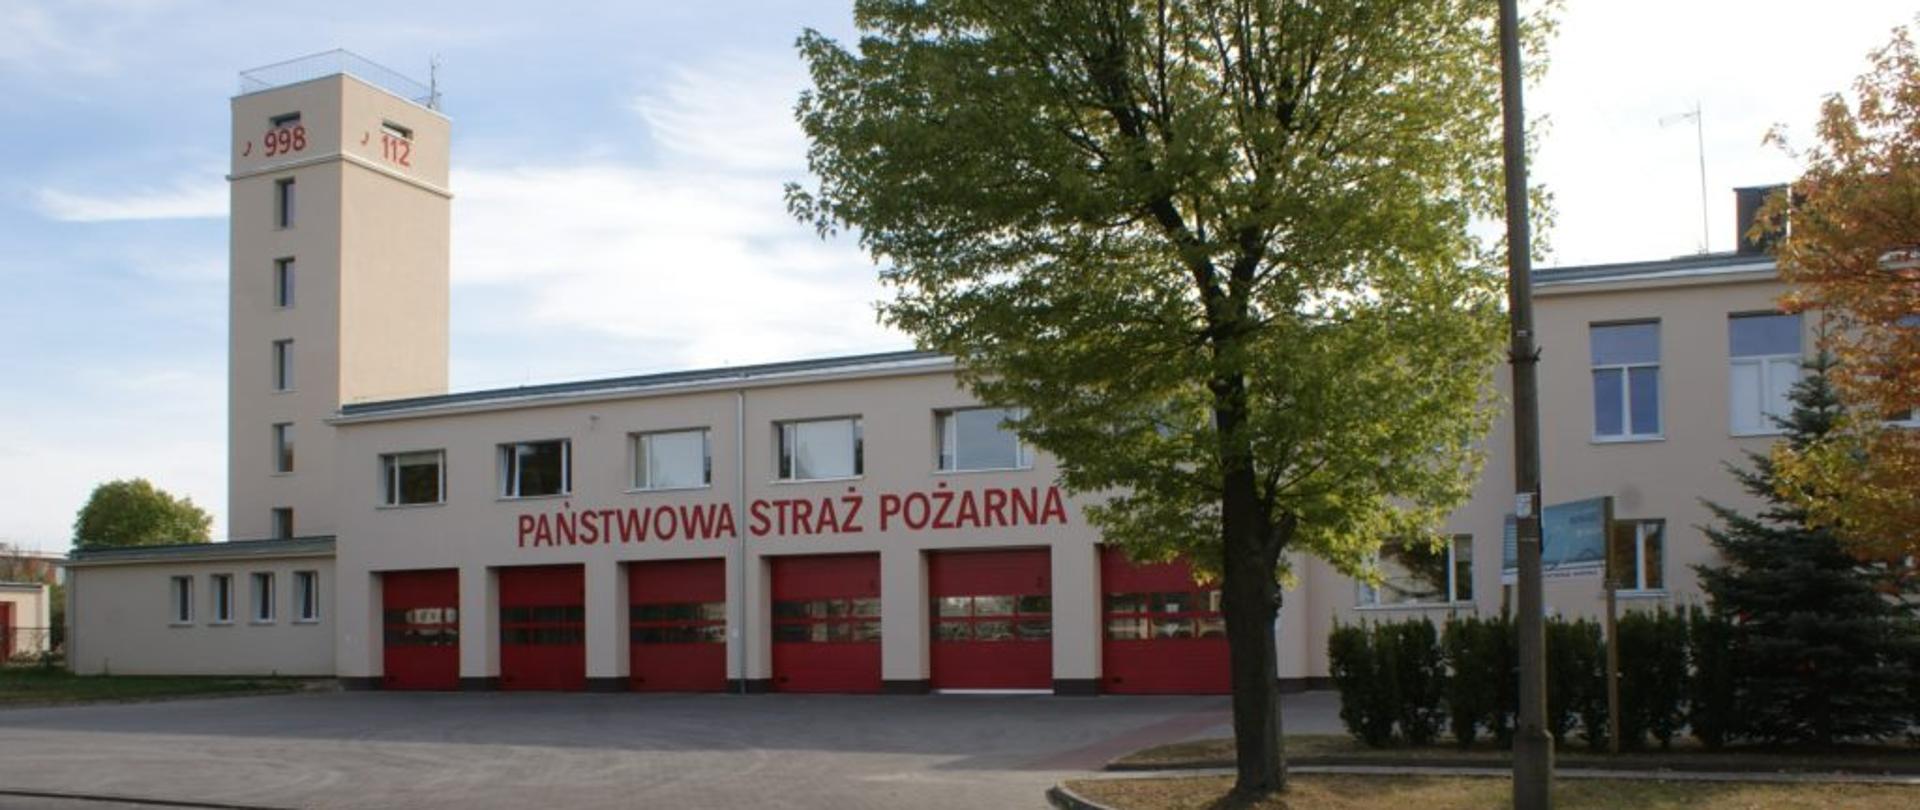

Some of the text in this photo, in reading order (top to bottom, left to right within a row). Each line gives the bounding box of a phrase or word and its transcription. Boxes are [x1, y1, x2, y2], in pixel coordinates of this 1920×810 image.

[264, 126, 306, 157] 998
[381, 135, 411, 166] 112
[518, 482, 1068, 547] PAŃSTWOWA STRAŻ POŻARNA
